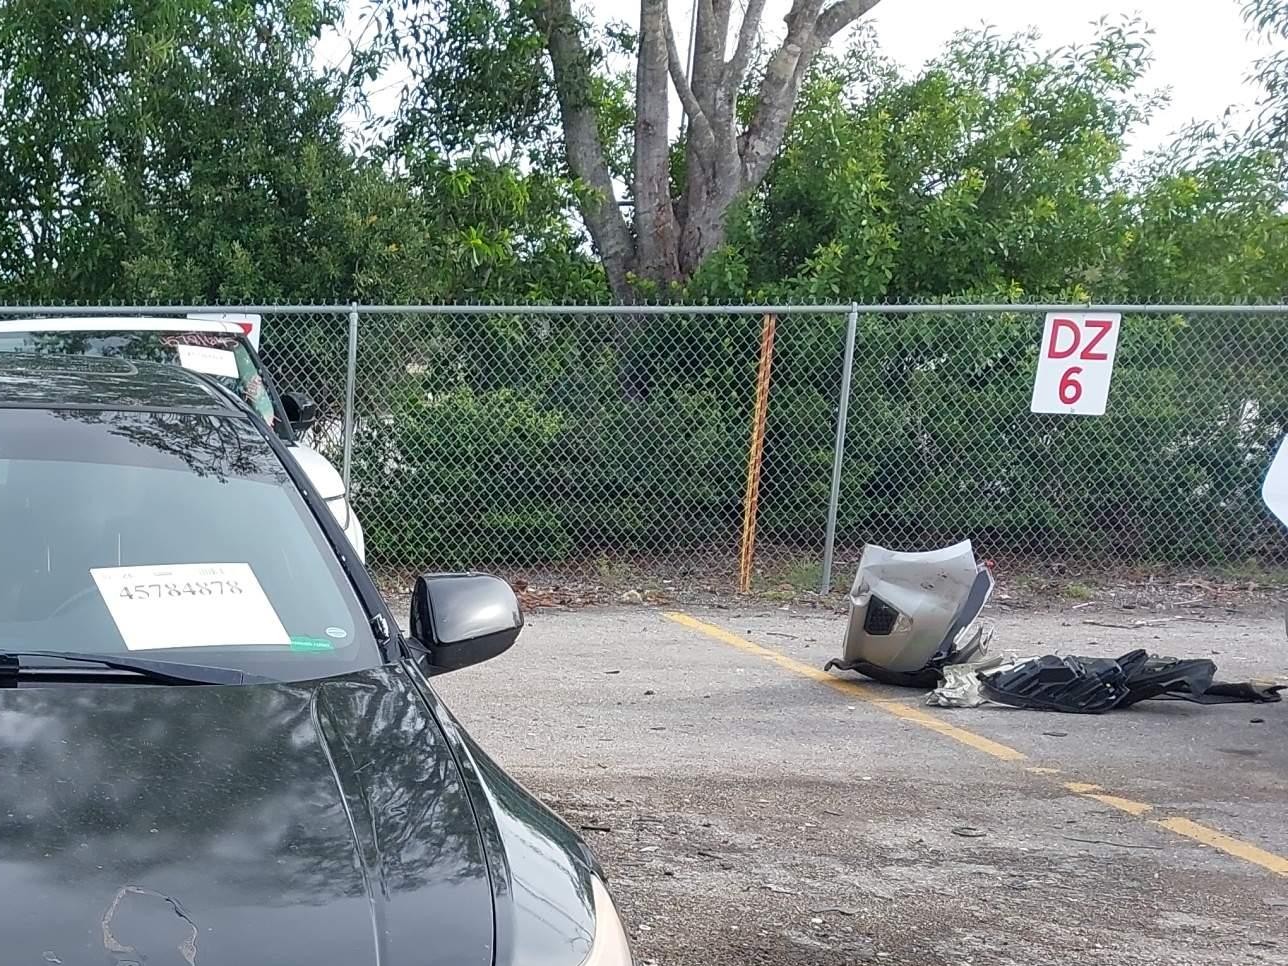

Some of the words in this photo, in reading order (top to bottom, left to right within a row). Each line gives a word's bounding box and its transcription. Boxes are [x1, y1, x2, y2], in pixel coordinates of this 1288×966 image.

[1047, 319, 1113, 360] DZ
[1058, 366, 1083, 405] 6
[119, 581, 243, 600] 45784878
